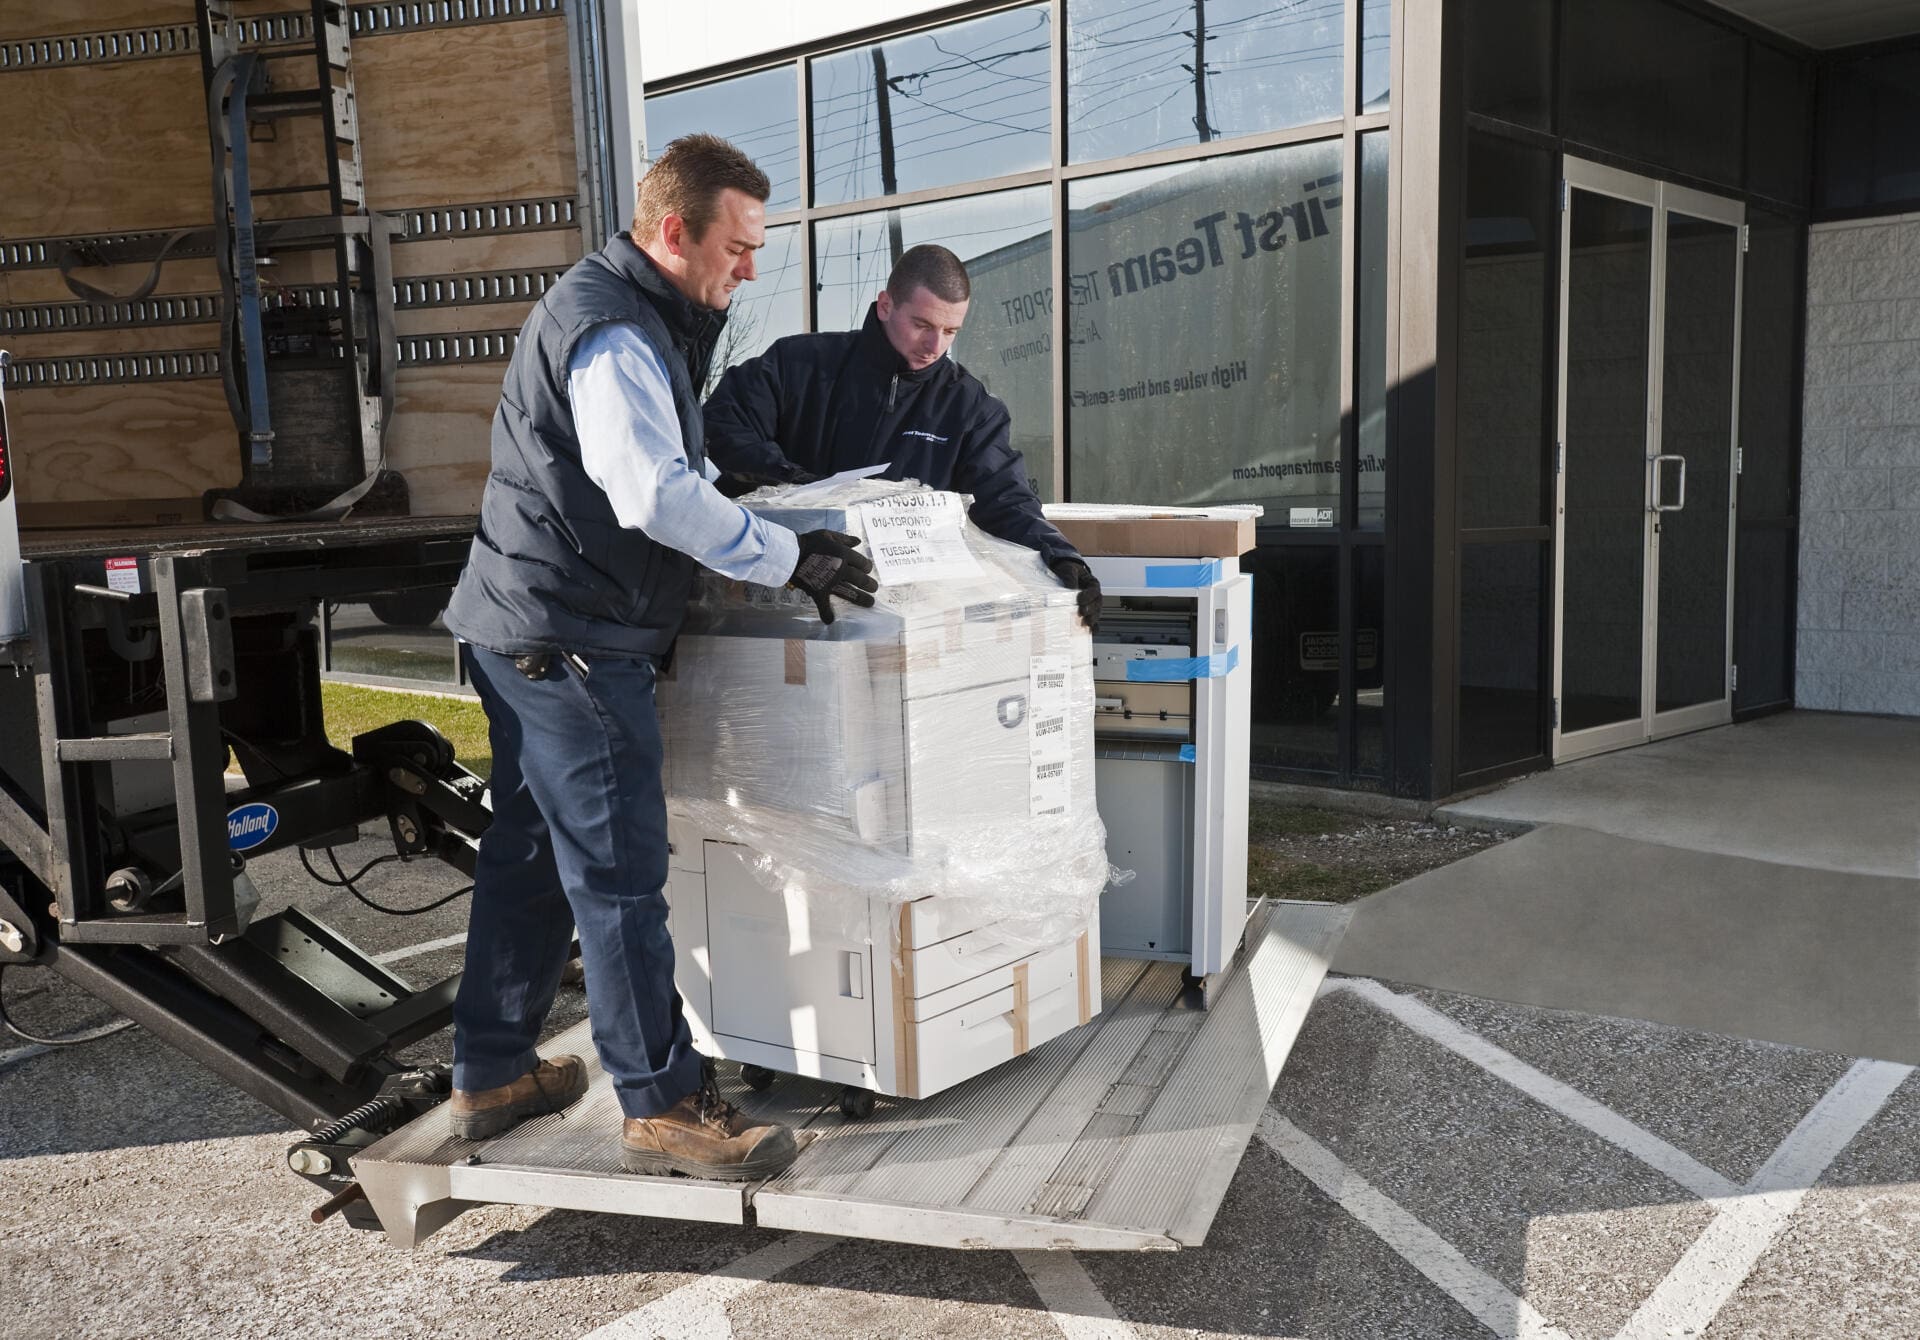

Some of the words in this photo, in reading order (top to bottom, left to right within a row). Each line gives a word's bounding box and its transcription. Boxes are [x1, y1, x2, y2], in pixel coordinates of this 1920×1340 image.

[1317, 510, 1333, 521] ADT
[880, 545, 921, 557] TUESDAY
[228, 808, 271, 839] Holland
